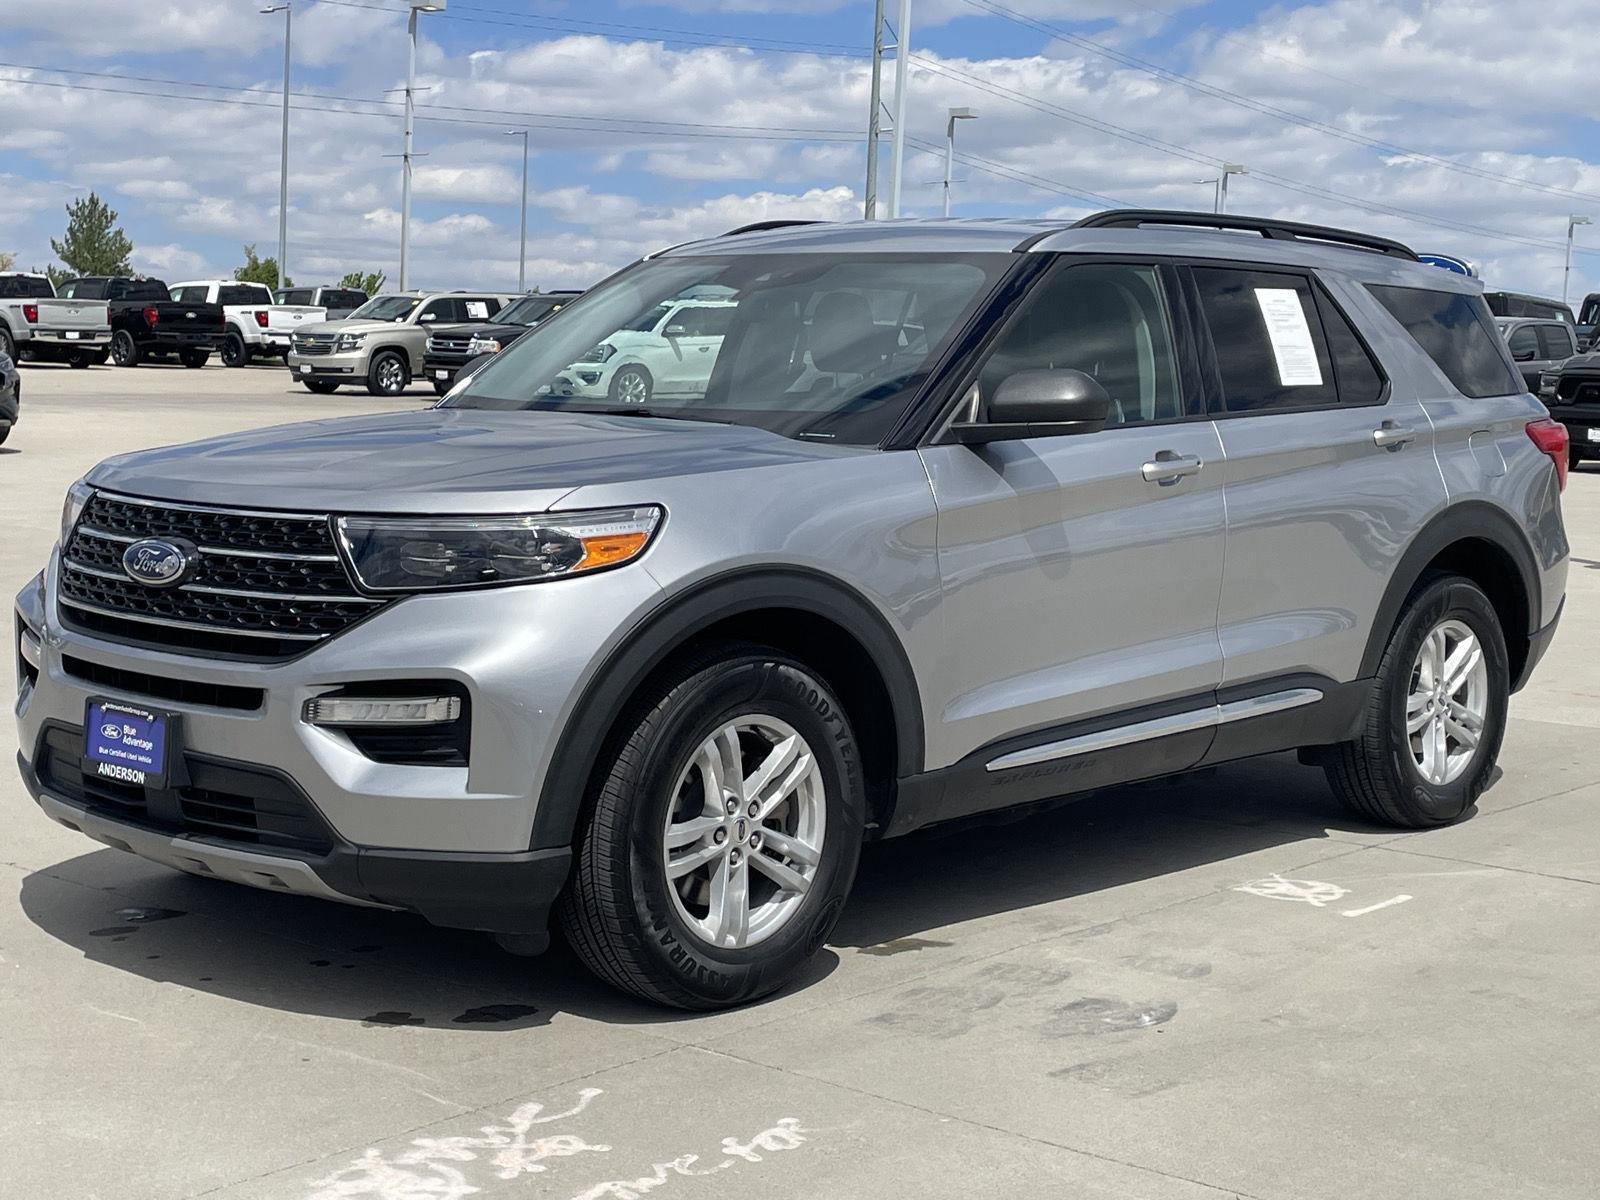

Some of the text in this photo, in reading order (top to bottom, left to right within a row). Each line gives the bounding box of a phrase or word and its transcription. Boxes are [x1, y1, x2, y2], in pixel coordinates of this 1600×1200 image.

[133, 547, 174, 574] Ford
[123, 724, 137, 736] Blue
[98, 746, 109, 755] Blue
[122, 735, 153, 751] Advantage
[98, 762, 145, 784] ANDERSON
